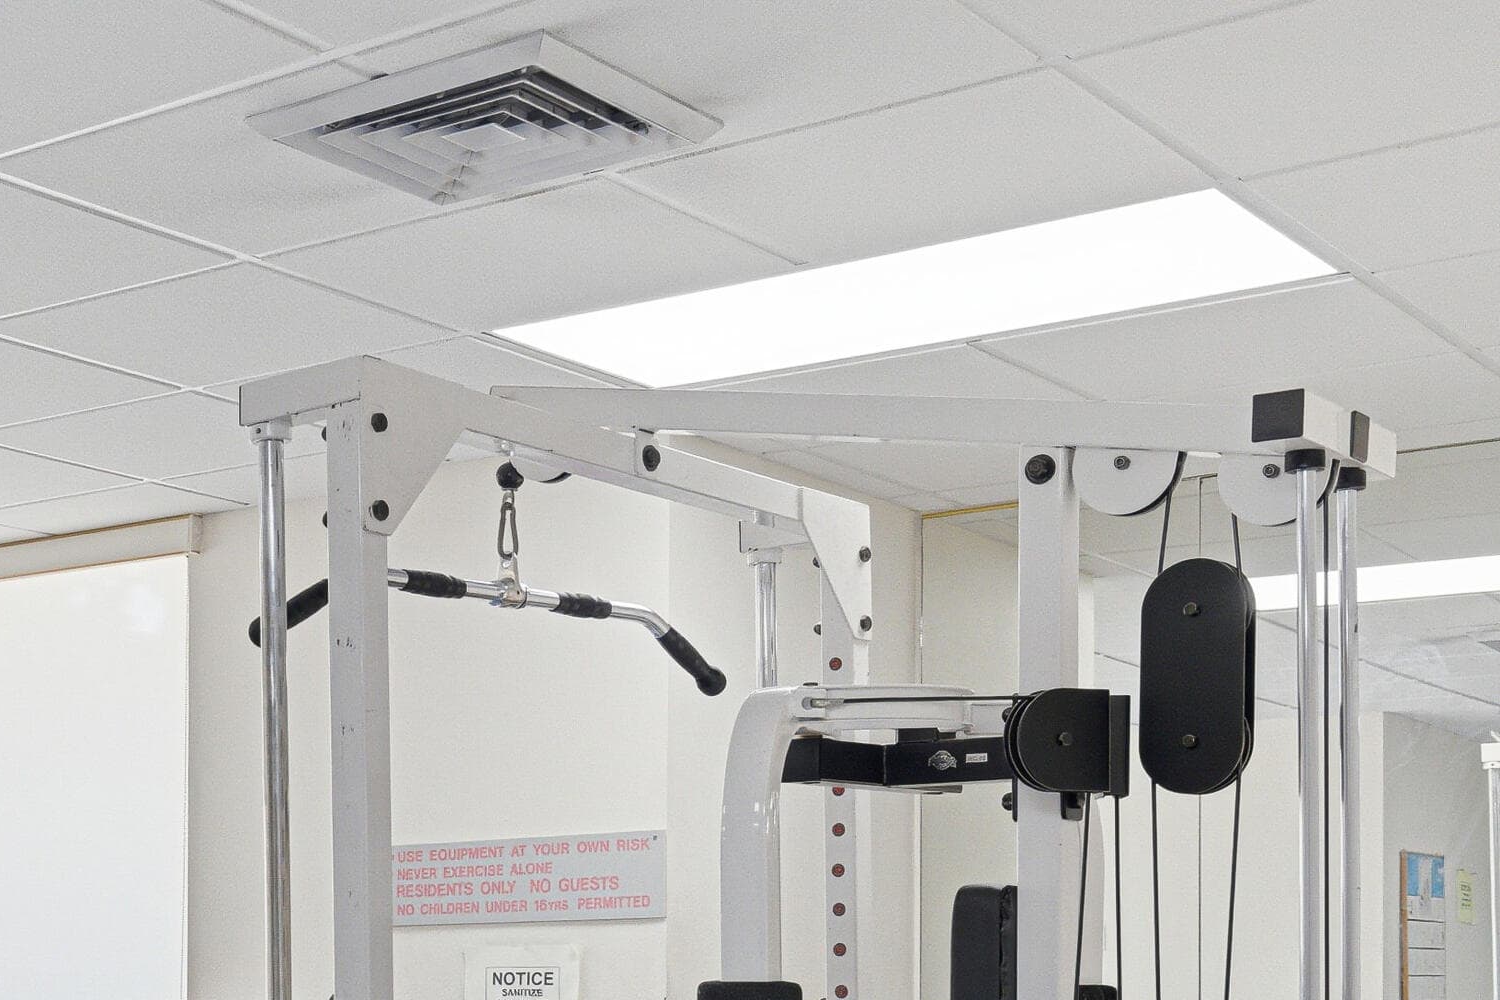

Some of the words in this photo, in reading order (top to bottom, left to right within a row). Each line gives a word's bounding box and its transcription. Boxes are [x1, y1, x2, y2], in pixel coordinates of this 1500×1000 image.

[398, 850, 423, 863] USE
[429, 846, 505, 861] EQUIPMENT
[510, 844, 527, 858] AT
[533, 842, 570, 856] YOUR
[576, 839, 610, 854] OWN
[616, 837, 651, 851] RISK
[397, 868, 438, 880] NEVER
[443, 864, 504, 878] EXERCISE
[510, 862, 553, 876] ALONE
[396, 882, 474, 898] RESIDENTS
[481, 880, 517, 895] ONLY
[530, 878, 551, 893] NO
[558, 876, 620, 892] GUESTS
[397, 903, 415, 915] NO
[420, 901, 480, 914] CHILDREN
[485, 899, 528, 913] UNDER
[577, 895, 651, 910] PERMITTED
[492, 971, 554, 986] NOTICE
[501, 988, 543, 997] SANITIZE
